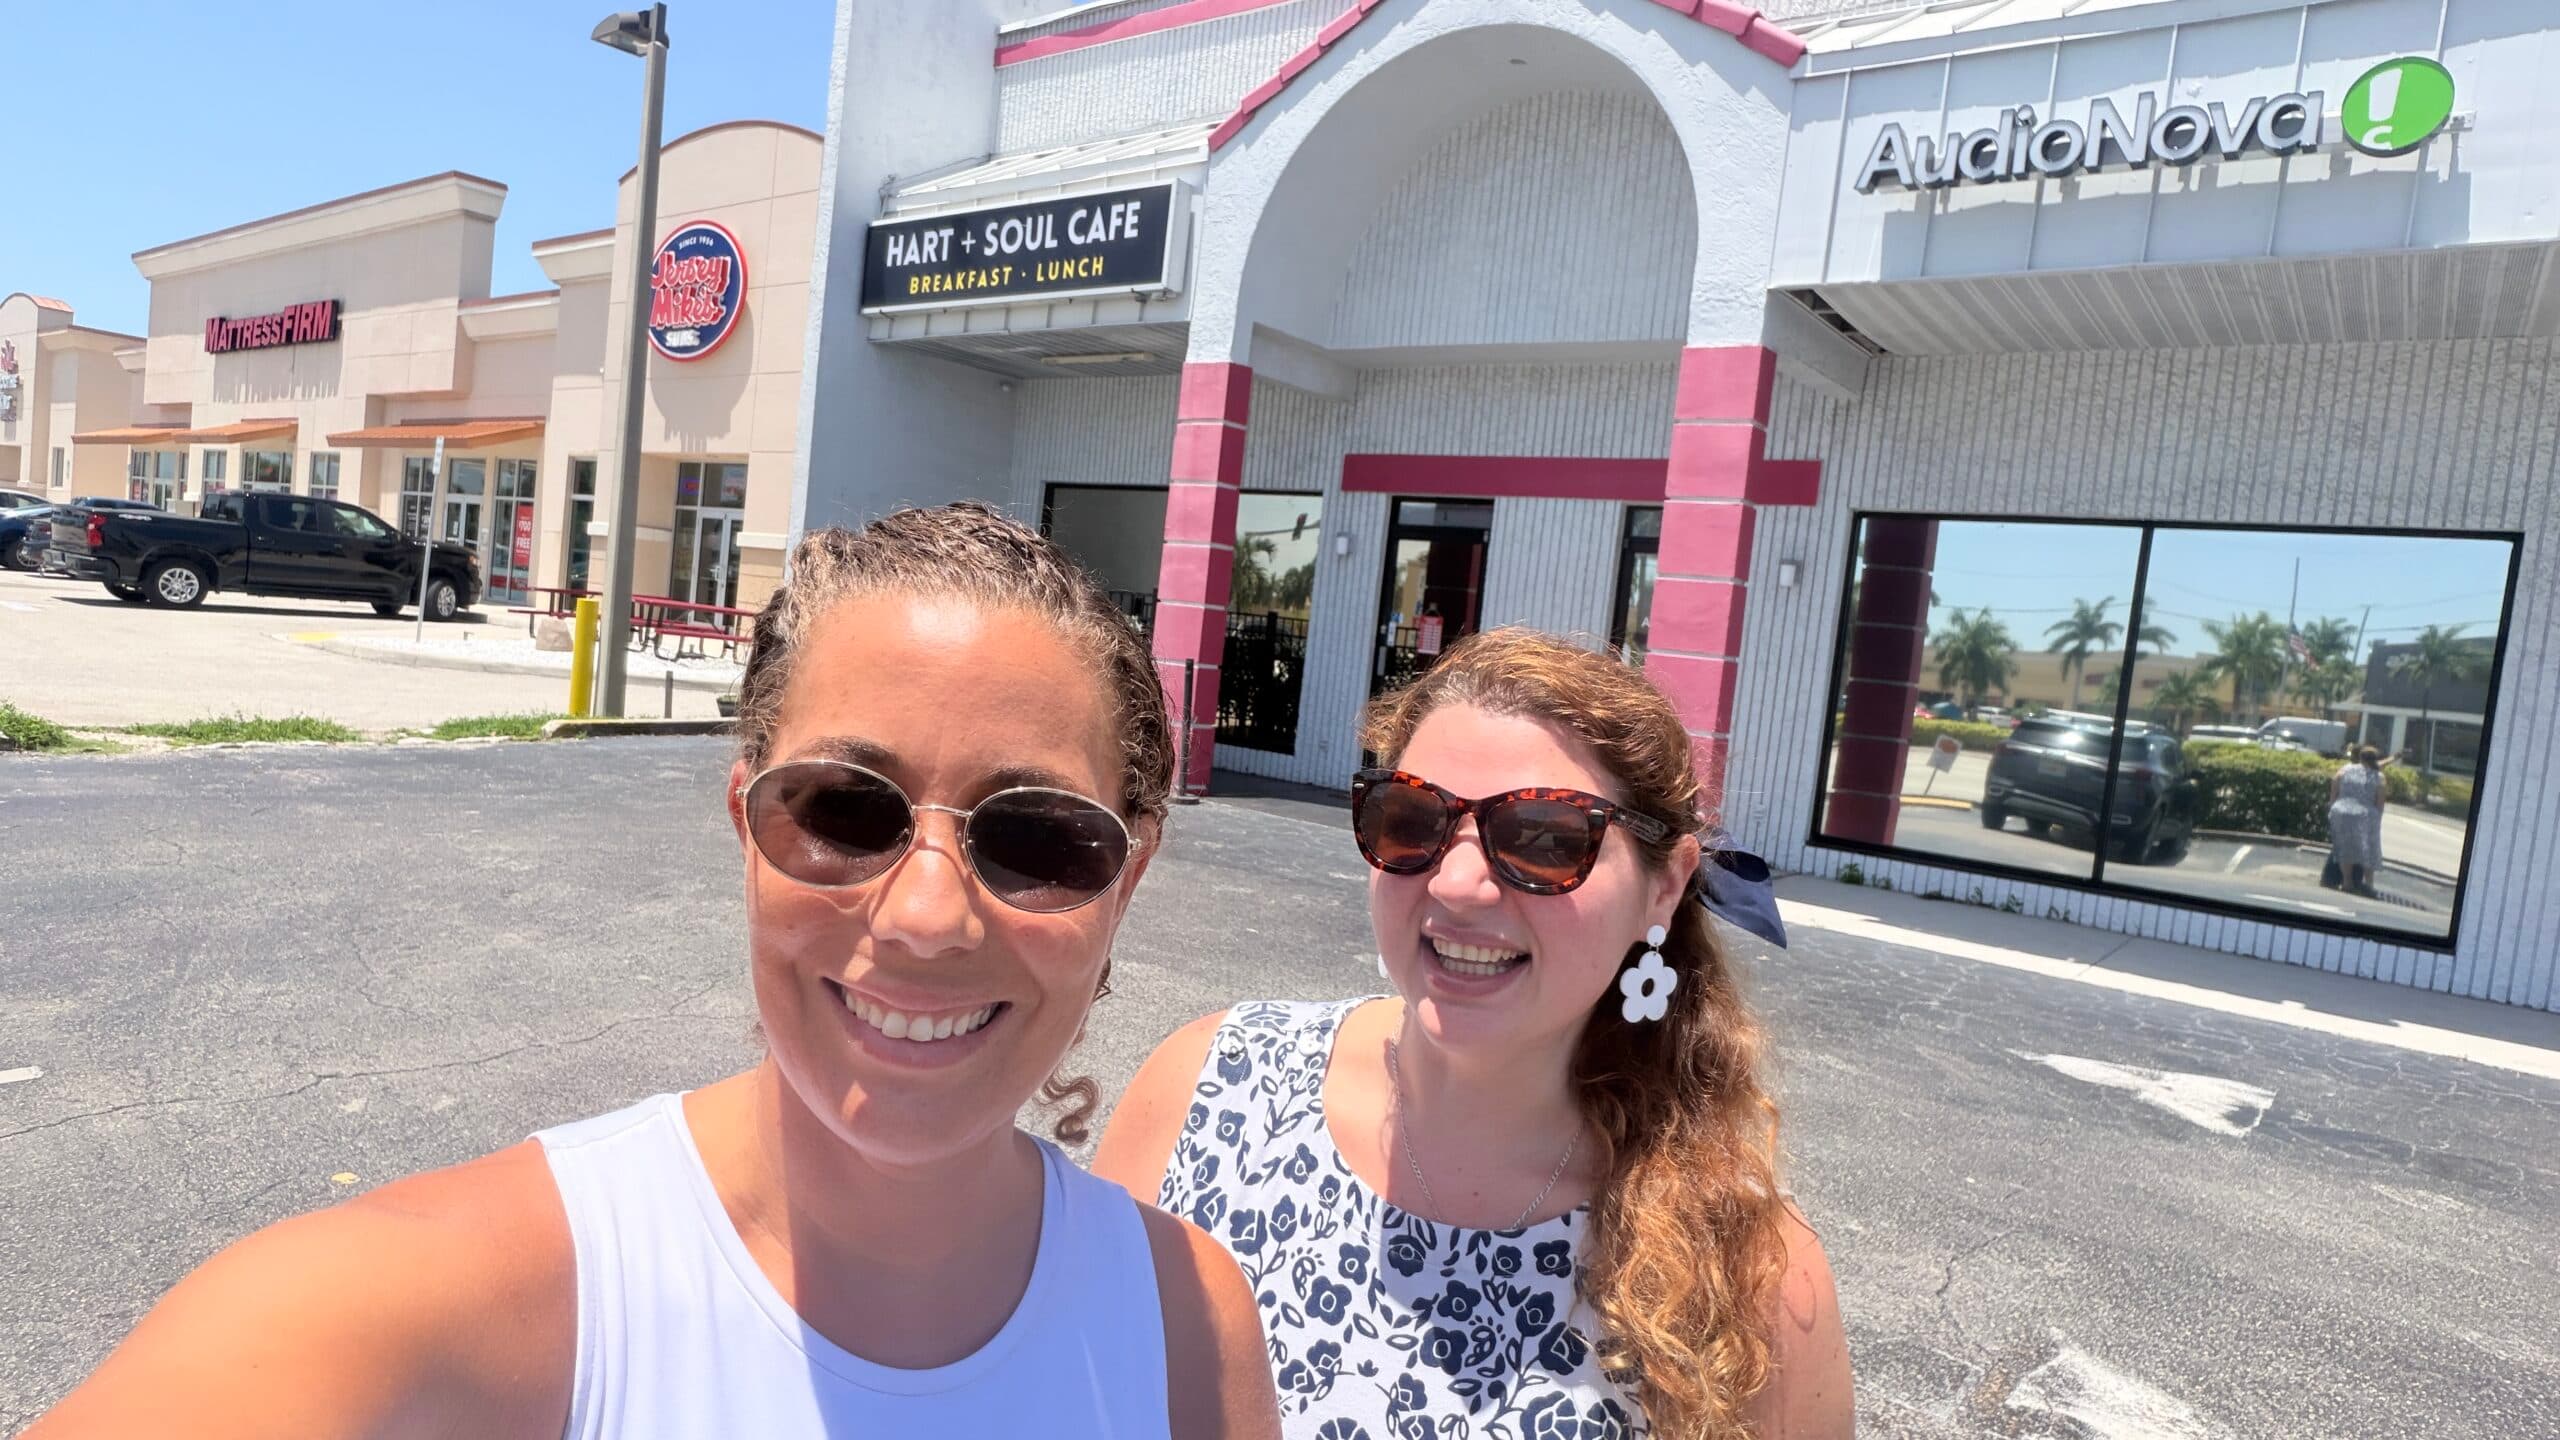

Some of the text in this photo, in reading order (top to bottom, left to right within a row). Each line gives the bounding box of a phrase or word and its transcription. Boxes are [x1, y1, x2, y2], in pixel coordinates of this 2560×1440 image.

[1854, 89, 2325, 194] AudioNova
[679, 236, 696, 249] SINCE
[886, 228, 955, 268] HART
[983, 213, 1059, 258] SOUL
[1067, 200, 1142, 247] CAFE
[651, 251, 731, 297] Jersey
[908, 256, 1105, 296] BREAKFAST LUNCH
